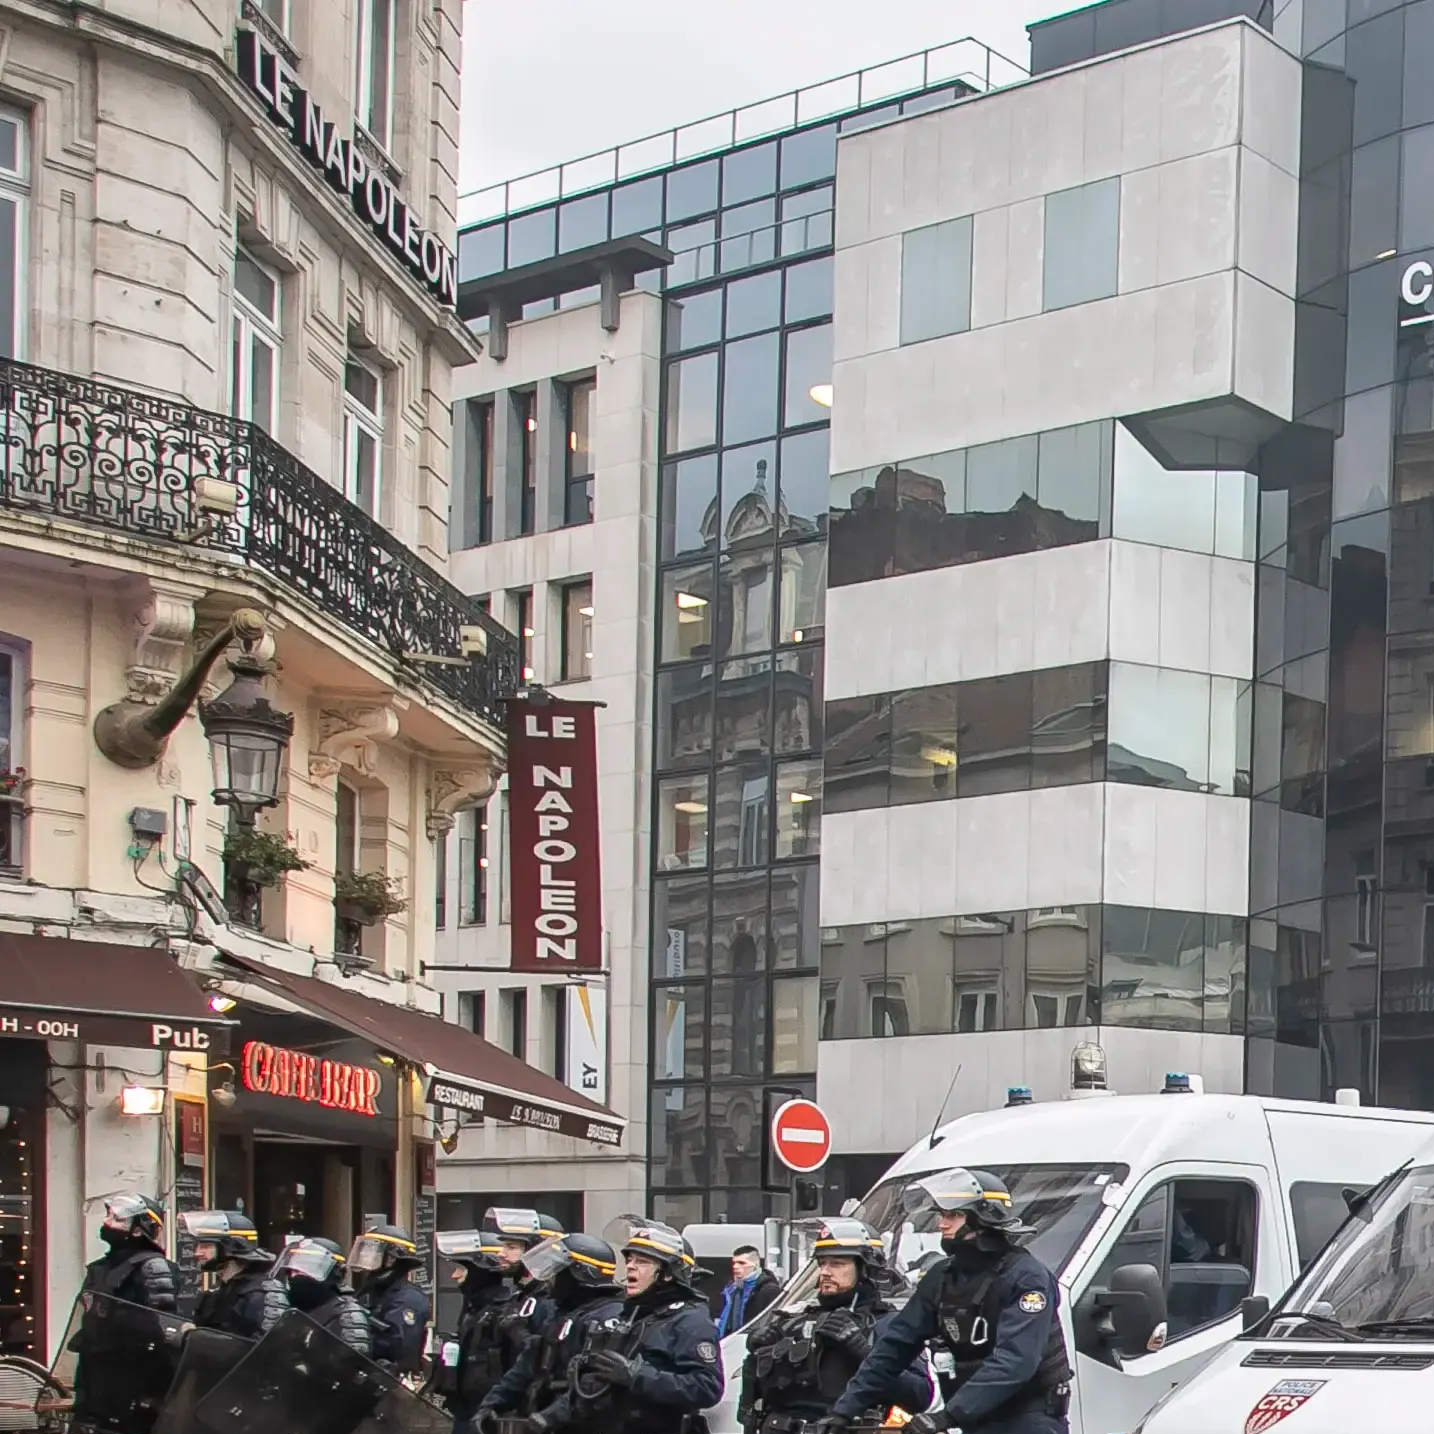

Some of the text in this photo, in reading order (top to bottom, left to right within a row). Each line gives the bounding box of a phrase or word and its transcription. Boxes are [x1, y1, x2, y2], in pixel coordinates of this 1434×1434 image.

[254, 31, 458, 306] LE NAPOLEON
[525, 714, 576, 738] LE
[533, 764, 578, 960] NAPOLEON
[152, 1024, 210, 1049] Pub
[582, 1062, 598, 1089] EY
[434, 1085, 485, 1111] RESTAURANT
[1258, 1396, 1304, 1411] CRS
